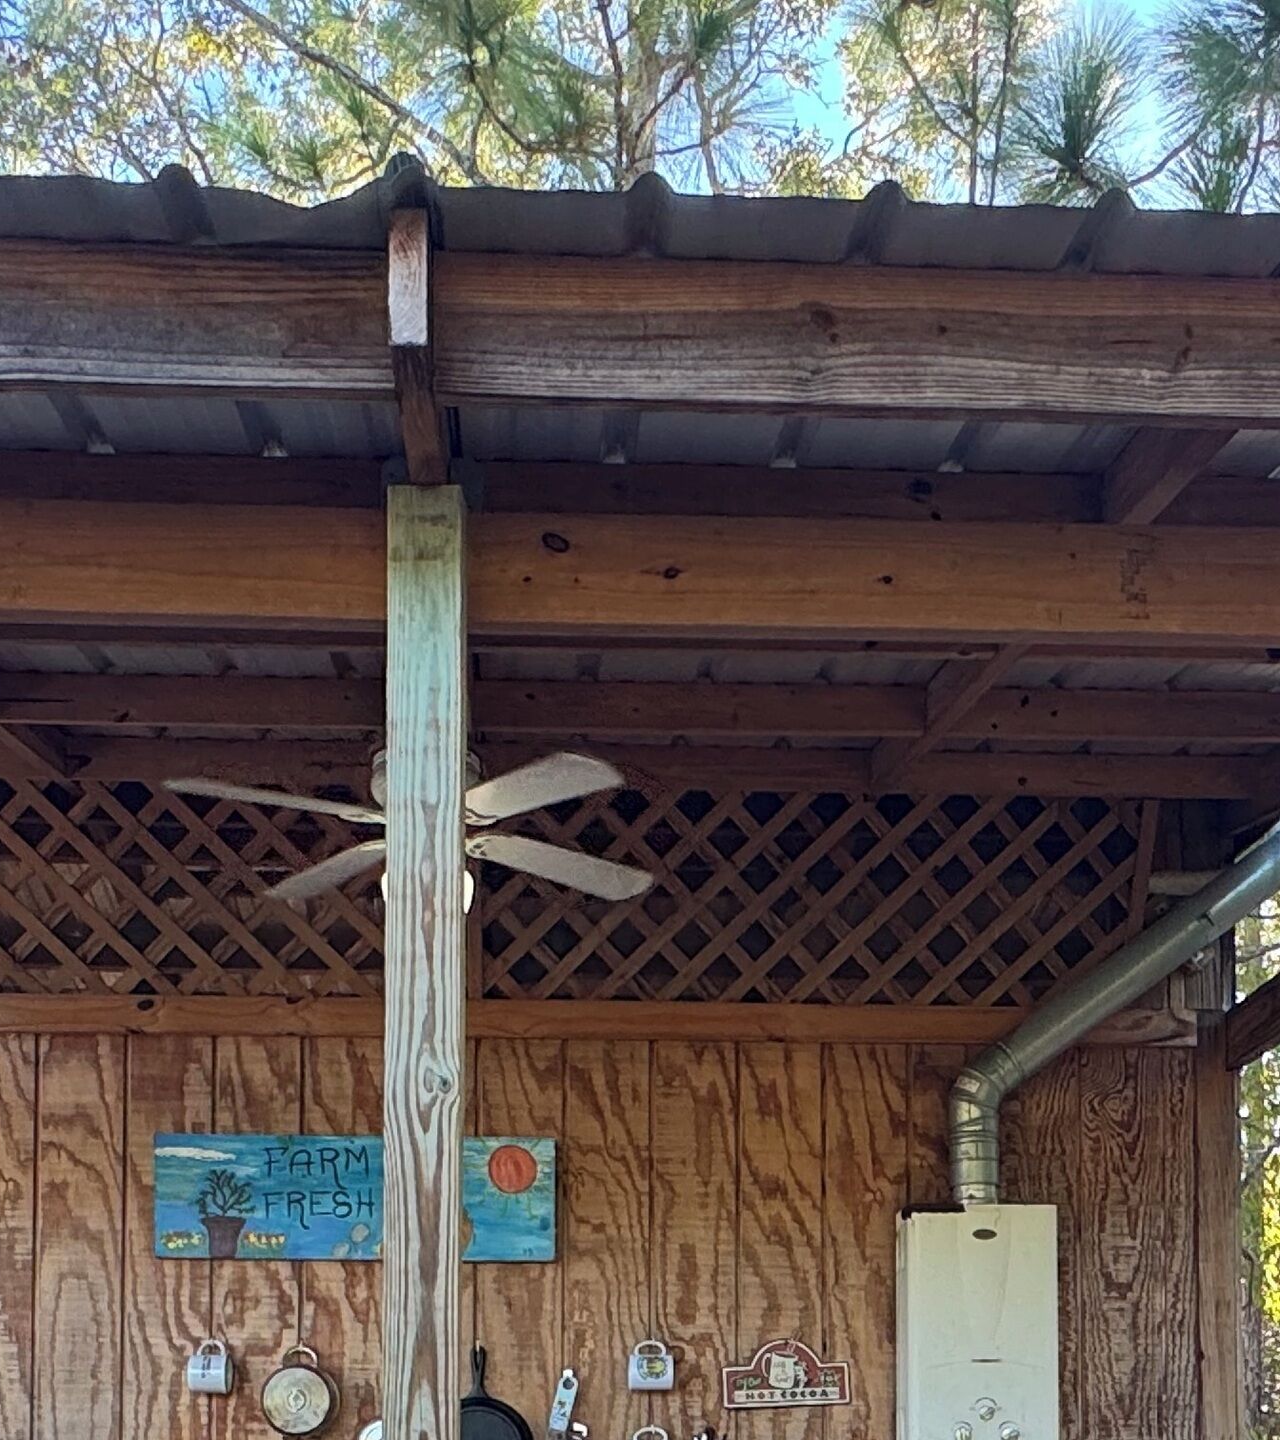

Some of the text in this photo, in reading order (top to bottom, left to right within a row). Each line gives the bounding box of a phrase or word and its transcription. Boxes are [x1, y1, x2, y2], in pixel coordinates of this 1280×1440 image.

[263, 1145, 369, 1189] FARM
[261, 1190, 375, 1229] FRESH
[745, 1389, 829, 1400] HOT COCOA
